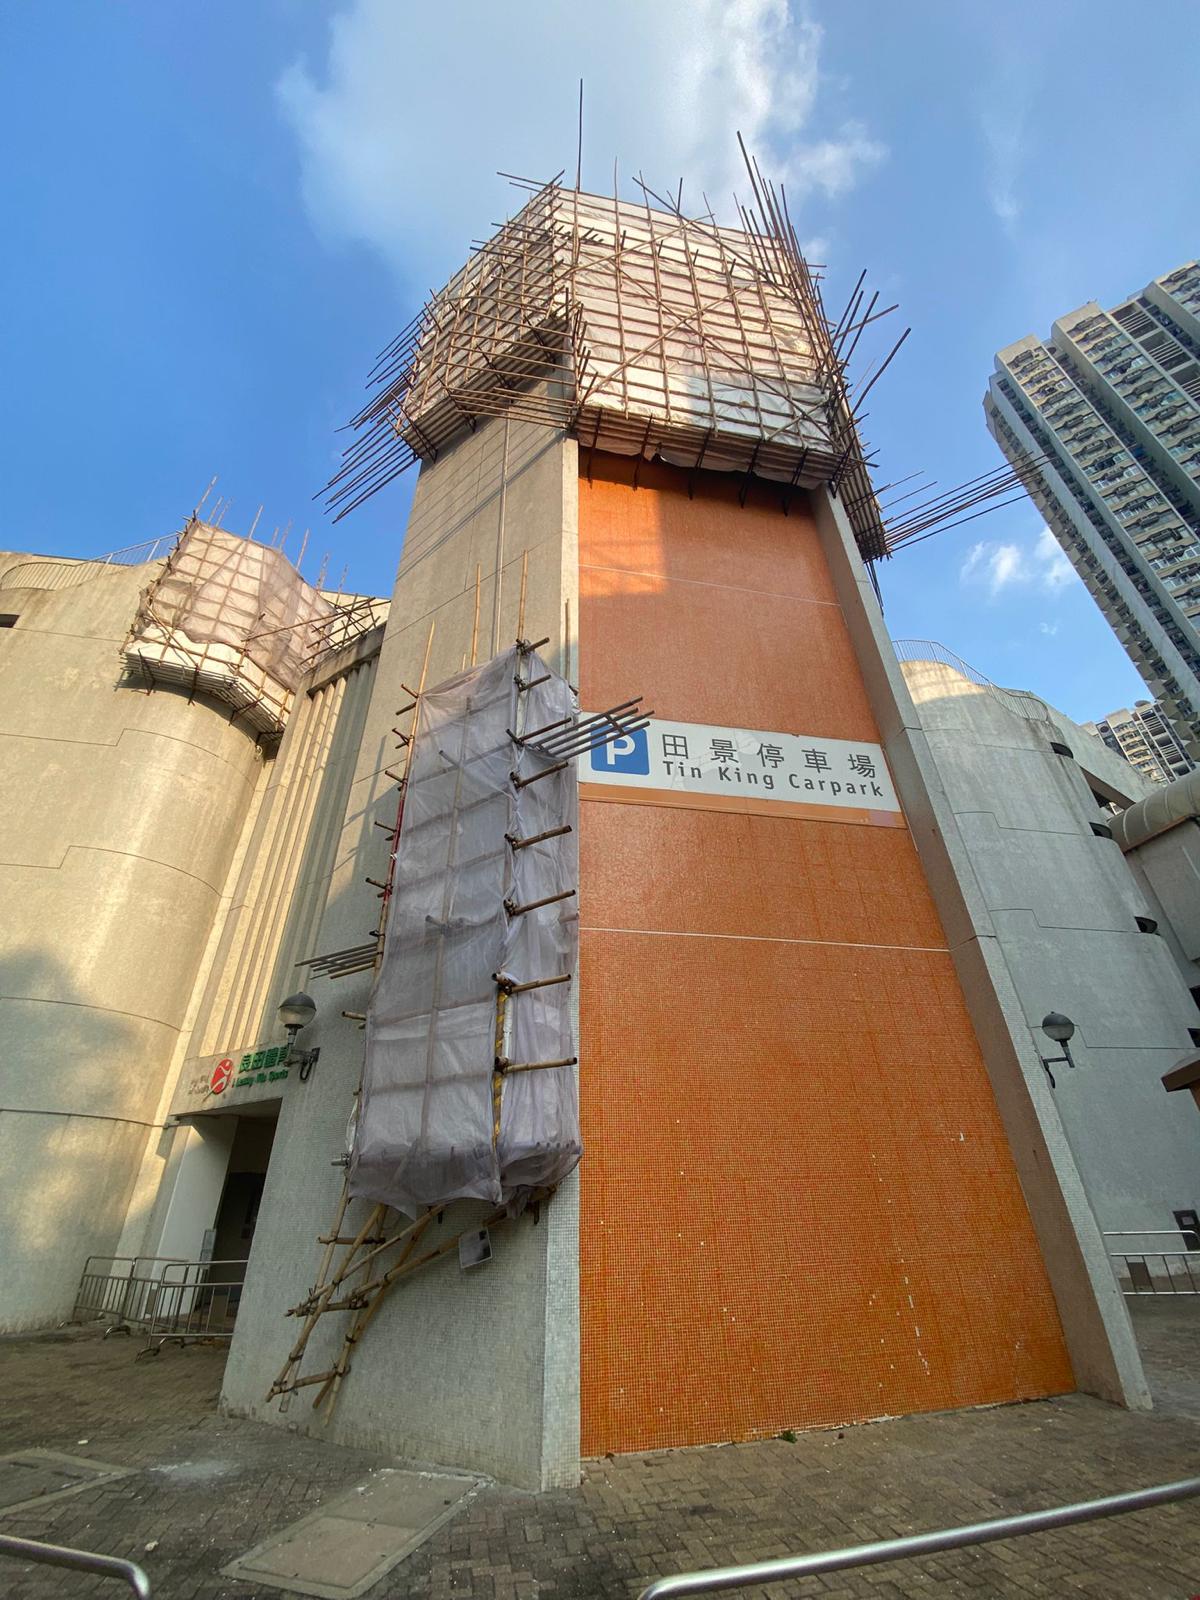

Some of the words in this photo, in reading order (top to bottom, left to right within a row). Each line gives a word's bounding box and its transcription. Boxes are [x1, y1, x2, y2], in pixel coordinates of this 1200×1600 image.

[605, 731, 636, 765] P
[661, 733, 876, 778] 田景停車場
[662, 760, 702, 779] Tin
[718, 766, 775, 790] King
[788, 773, 884, 797] Carpark
